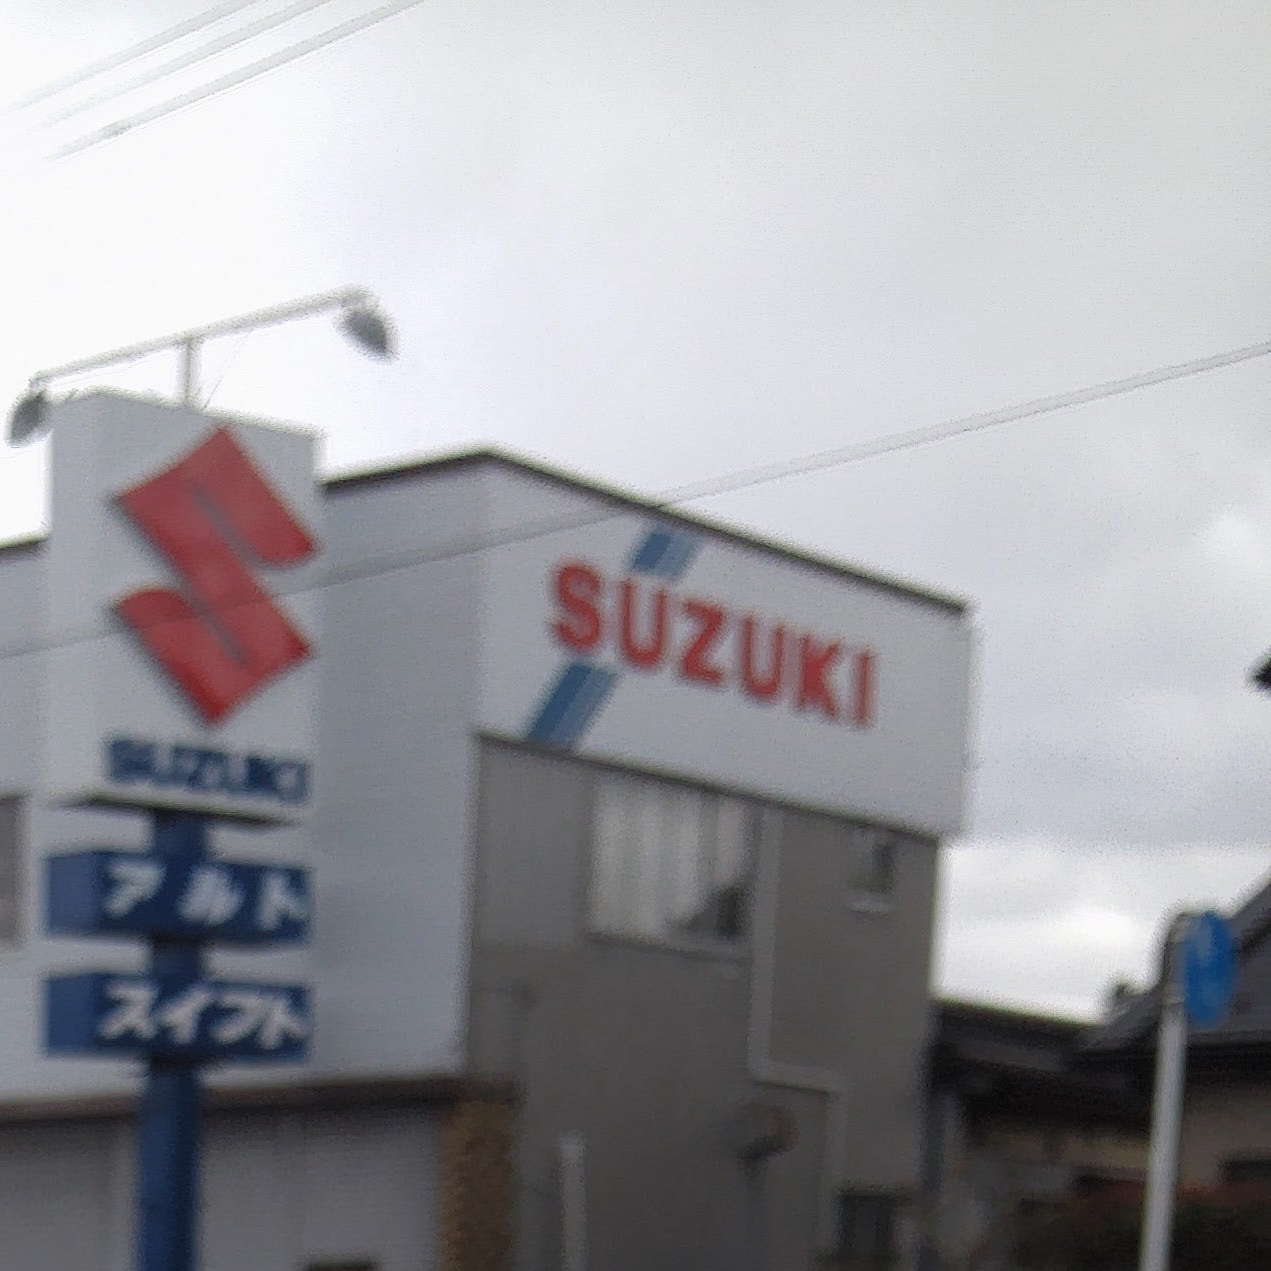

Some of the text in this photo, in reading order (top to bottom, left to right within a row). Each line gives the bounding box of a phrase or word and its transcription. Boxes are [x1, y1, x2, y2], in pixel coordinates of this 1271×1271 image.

[551, 560, 875, 727] SUZUKI
[105, 738, 311, 802] SUZUKI
[103, 860, 311, 930] アルト
[95, 982, 313, 1050] スイフト
